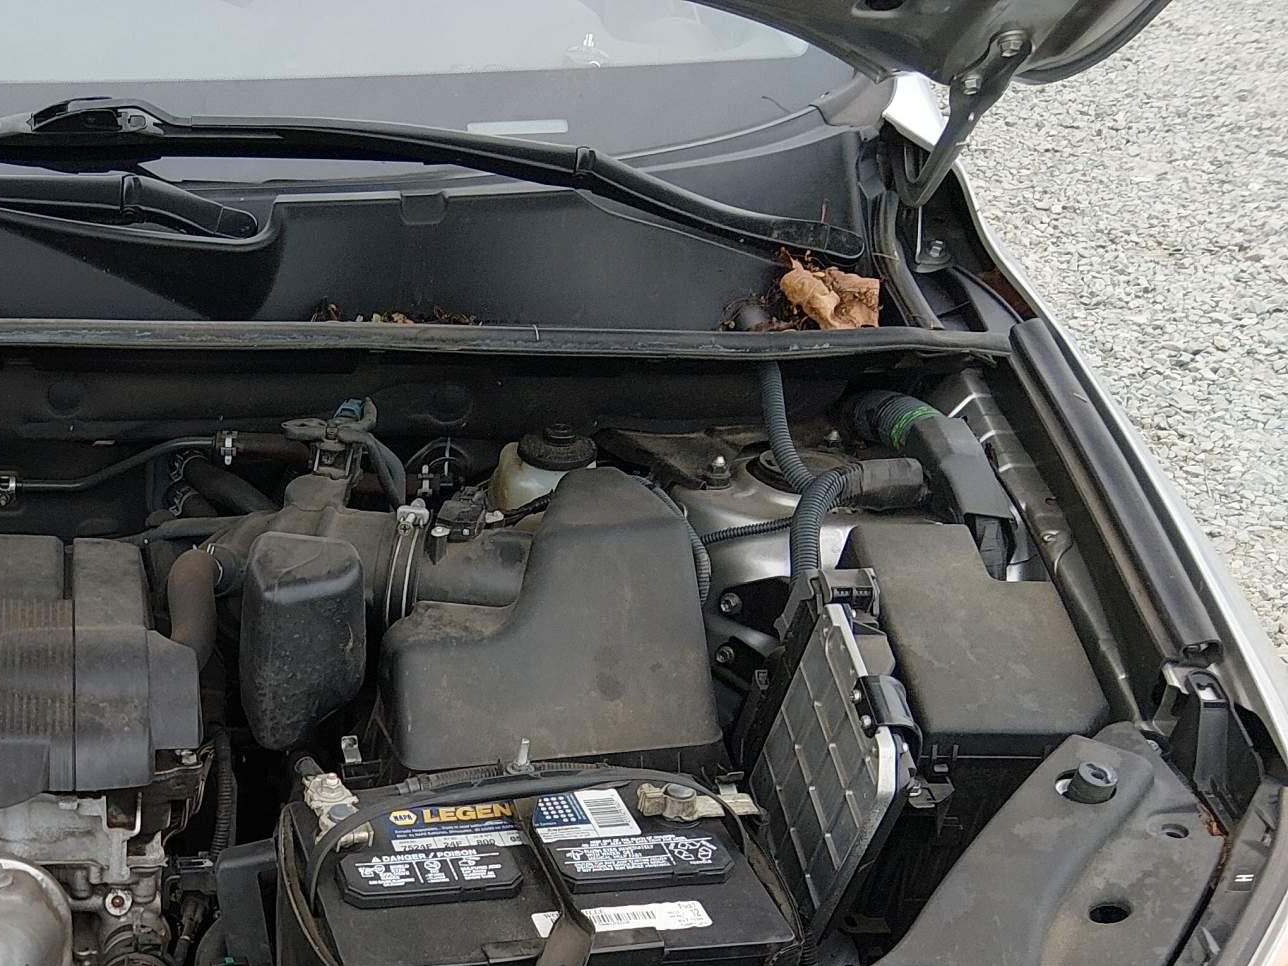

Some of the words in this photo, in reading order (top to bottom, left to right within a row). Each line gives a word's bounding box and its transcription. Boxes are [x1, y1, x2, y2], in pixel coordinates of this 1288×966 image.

[422, 802, 517, 824] LEGEN
[382, 852, 426, 862] DANGER
[436, 849, 477, 858] POISON
